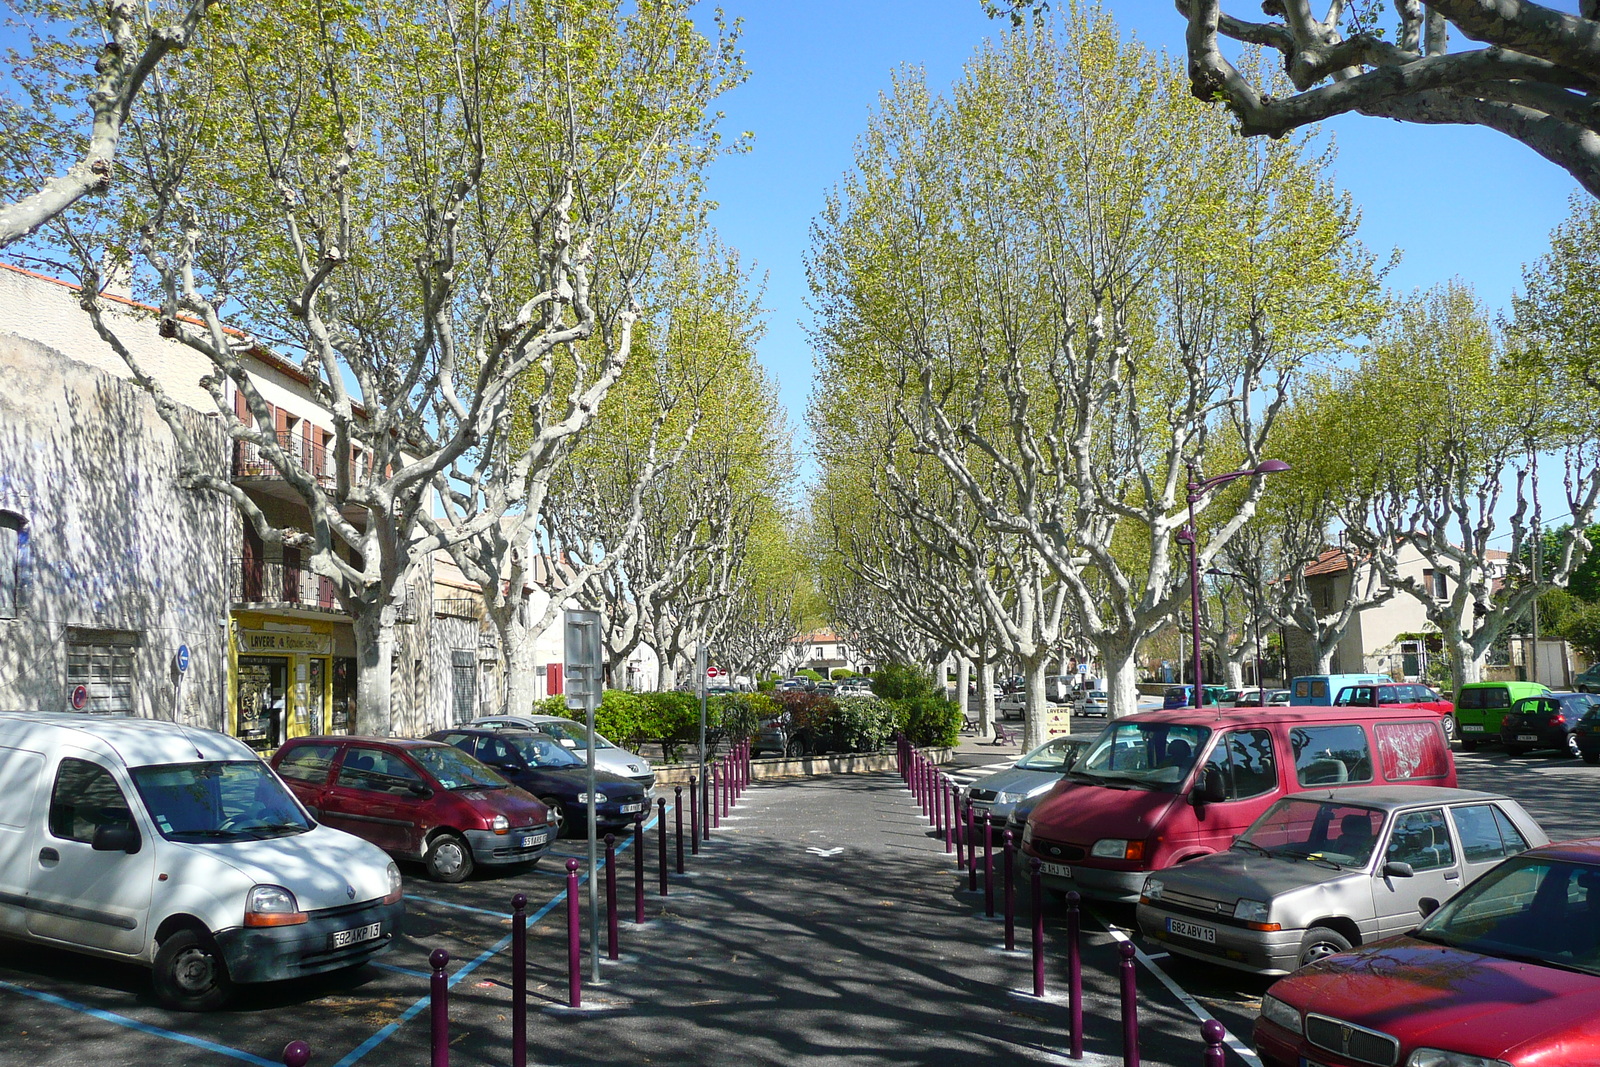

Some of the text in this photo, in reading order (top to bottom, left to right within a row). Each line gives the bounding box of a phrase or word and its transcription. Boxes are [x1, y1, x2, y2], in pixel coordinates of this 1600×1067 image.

[250, 635, 275, 648] LAVERIE
[351, 927, 368, 943] AKP
[370, 924, 379, 938] 13
[1171, 920, 1214, 942] 682 ABV 13
